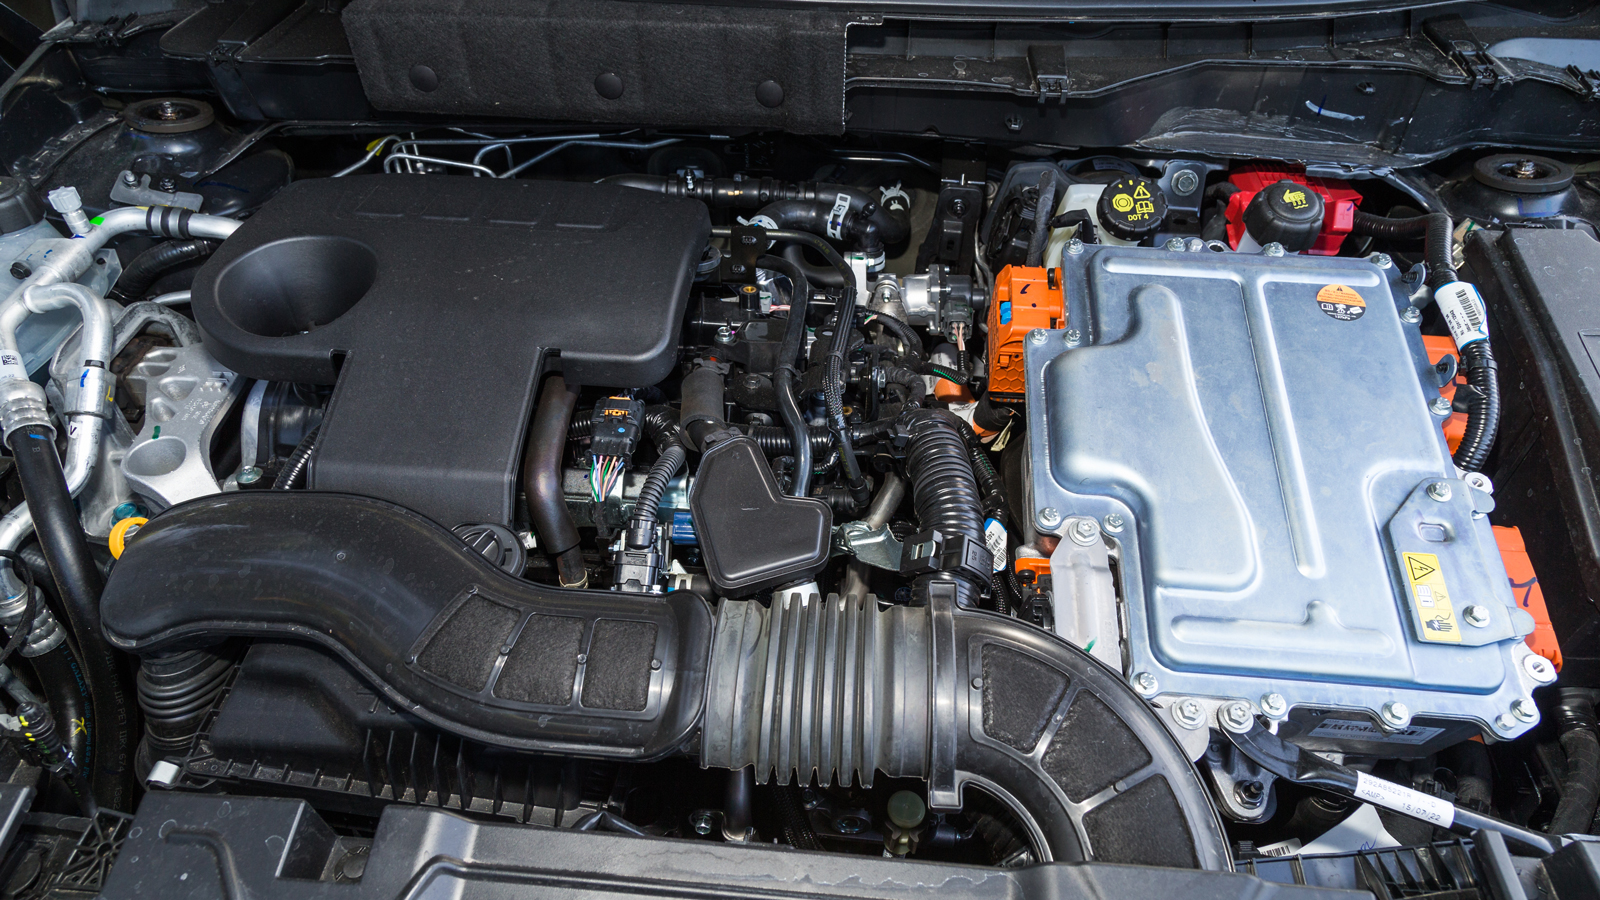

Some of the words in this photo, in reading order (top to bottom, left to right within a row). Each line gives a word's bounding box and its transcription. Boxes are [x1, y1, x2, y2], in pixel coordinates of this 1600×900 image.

[1127, 213, 1142, 221] DOT
[70, 662, 88, 698] GALAXY
[1402, 802, 1442, 822] 15/07/22
